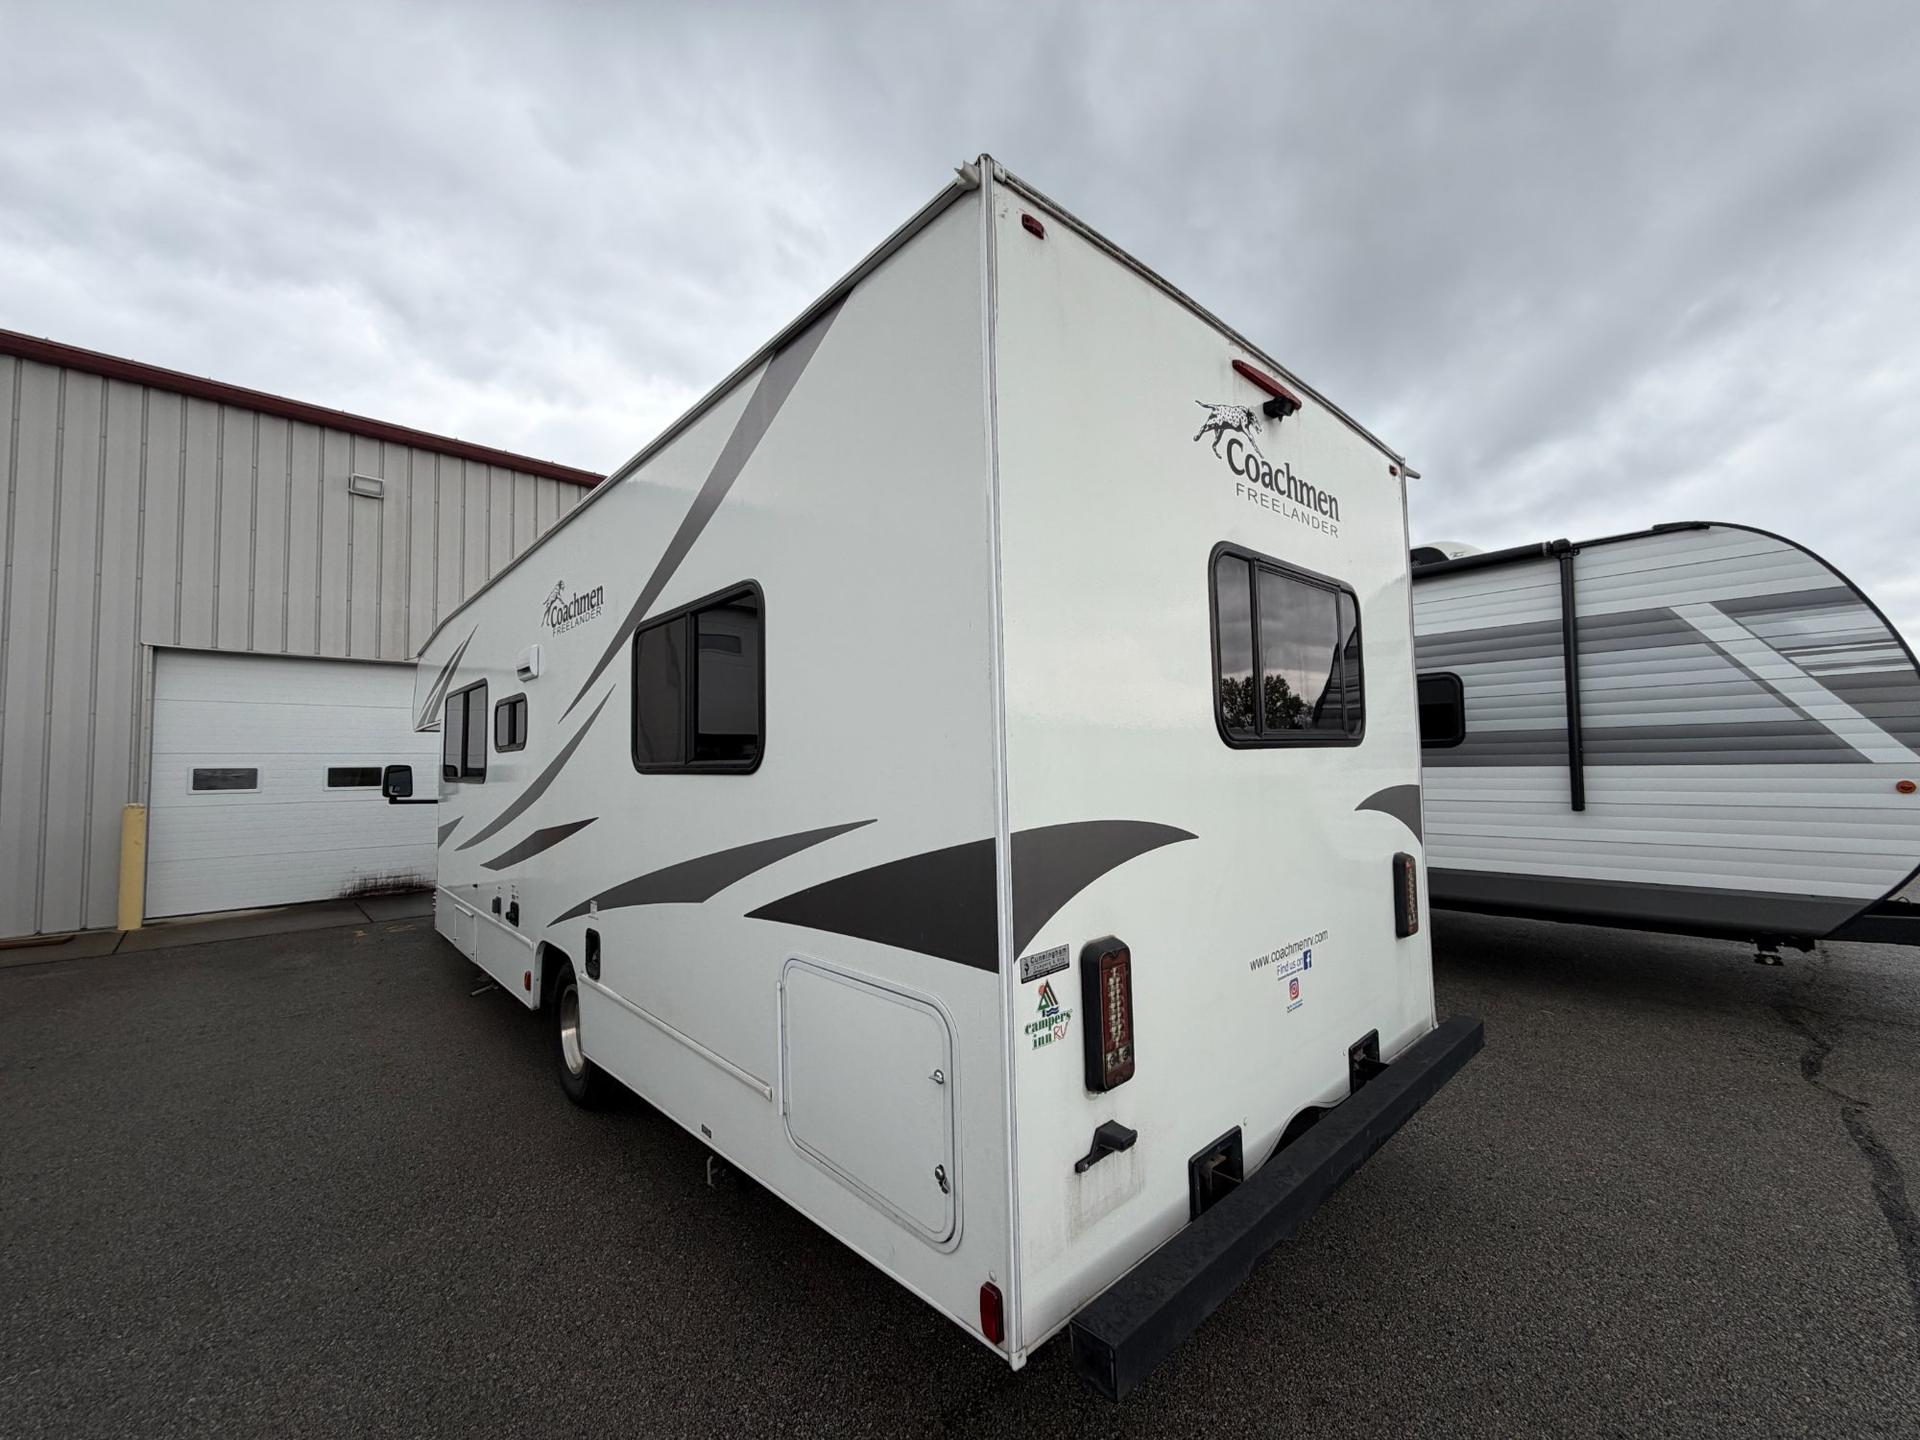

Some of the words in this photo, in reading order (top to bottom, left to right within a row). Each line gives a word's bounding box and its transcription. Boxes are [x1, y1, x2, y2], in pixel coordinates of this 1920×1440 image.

[1227, 438, 1340, 522] Coachmen
[1236, 483, 1338, 538] FREELANDER
[551, 585, 603, 627] Coachmen
[552, 607, 602, 638] FREELANDER
[1249, 930, 1329, 971] www.coachmenrv.com
[1277, 961, 1289, 976] Find
[1032, 1032, 1052, 1048] inn
[1053, 1022, 1069, 1040] RV
